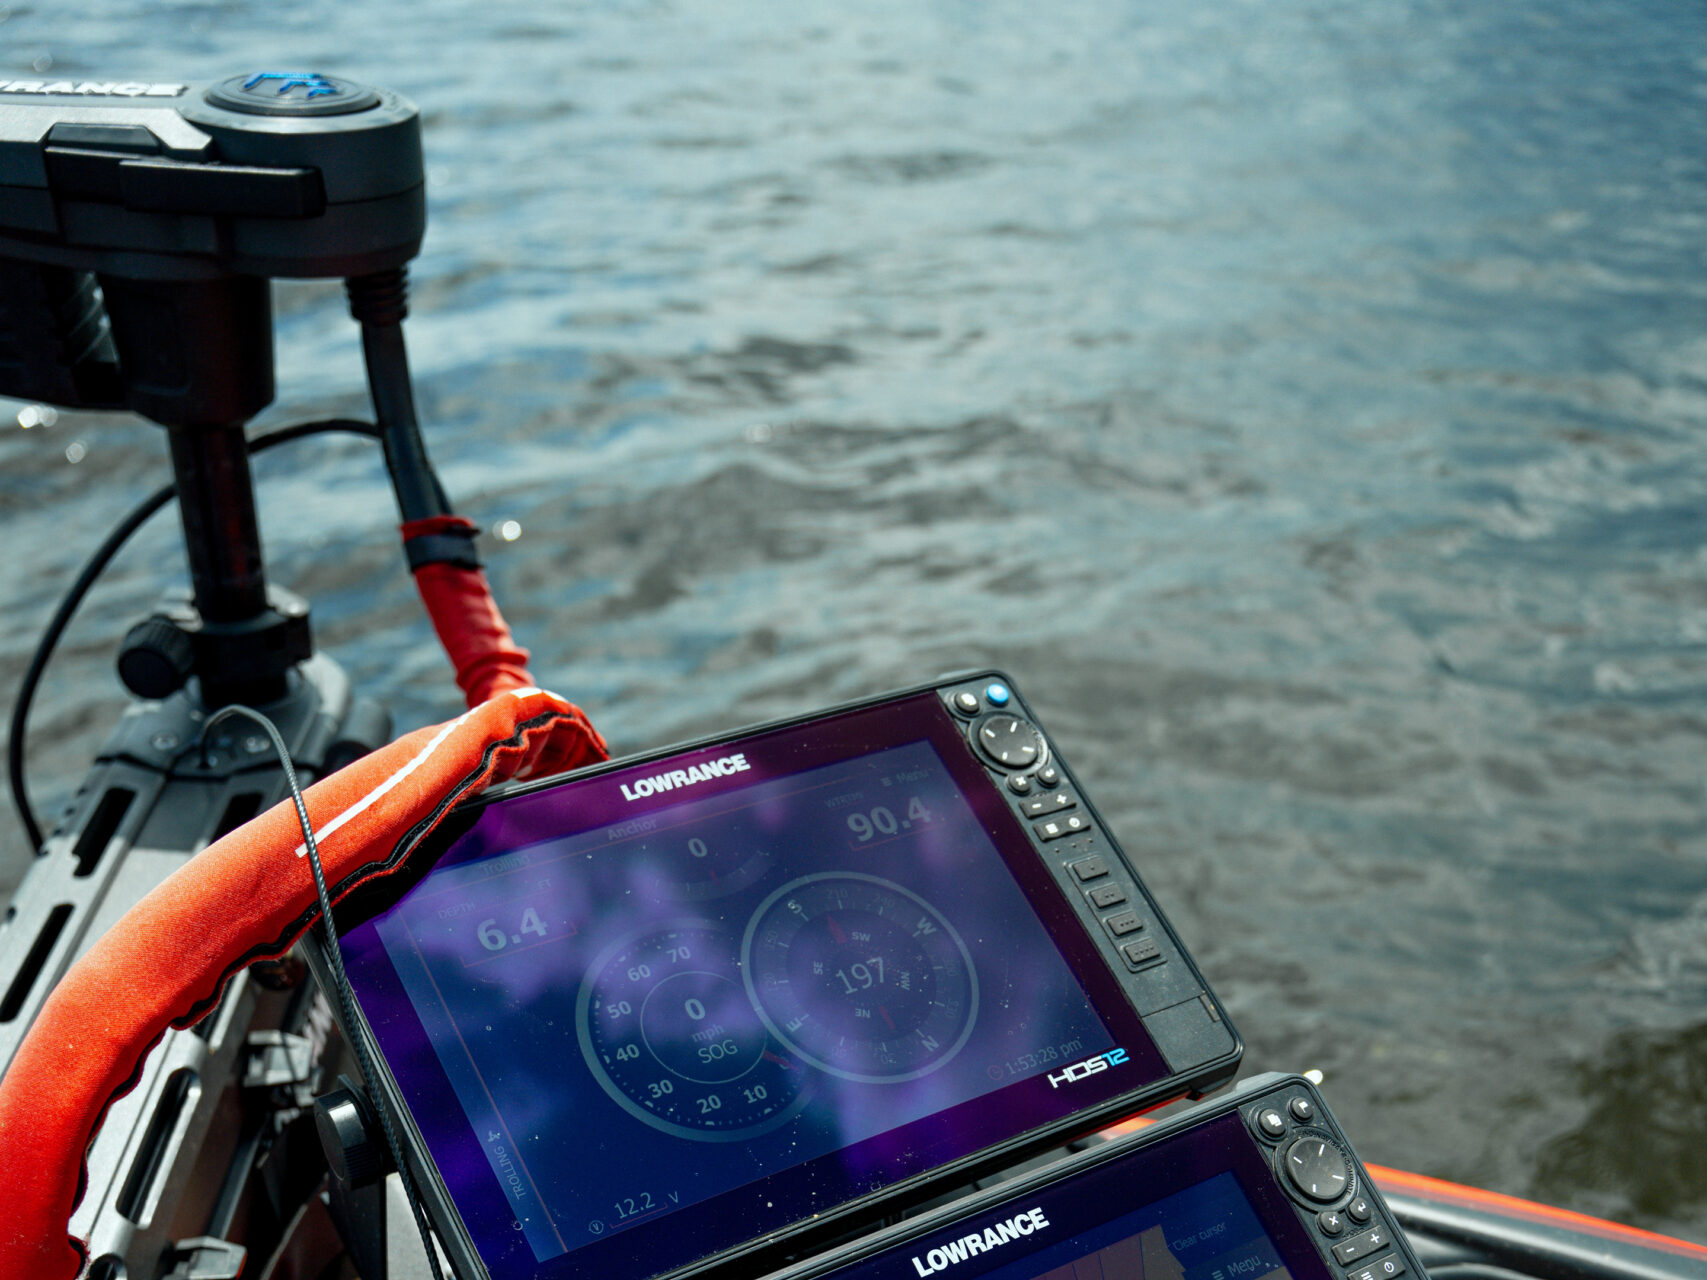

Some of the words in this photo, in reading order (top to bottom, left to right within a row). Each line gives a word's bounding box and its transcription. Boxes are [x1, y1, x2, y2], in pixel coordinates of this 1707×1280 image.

[620, 753, 751, 802] LOWRANCE
[608, 817, 658, 841] Anchor
[847, 796, 931, 842] 90.4
[688, 838, 708, 857] 0
[437, 902, 478, 921] DEPTH
[476, 908, 549, 951] 6.4
[915, 916, 938, 936] W
[851, 932, 871, 942] SW
[666, 946, 692, 964] 70
[626, 964, 652, 983] 60
[835, 956, 885, 995] 197
[606, 1001, 632, 1020] 50
[684, 998, 706, 1021] 0
[692, 1023, 725, 1043] mph
[616, 1044, 640, 1063] 40
[698, 1039, 738, 1064] SOG
[1004, 1046, 1059, 1075] 1:53:28
[1060, 1039, 1083, 1058] pm
[648, 1079, 674, 1099] 30
[743, 1085, 768, 1104] 10
[696, 1095, 722, 1115] 20
[494, 1146, 528, 1200] TROLLING
[613, 1191, 657, 1220] 12.2
[668, 1190, 681, 1205] V
[911, 1206, 1051, 1278] LOWRANCE
[1227, 1254, 1262, 1278] Menu
